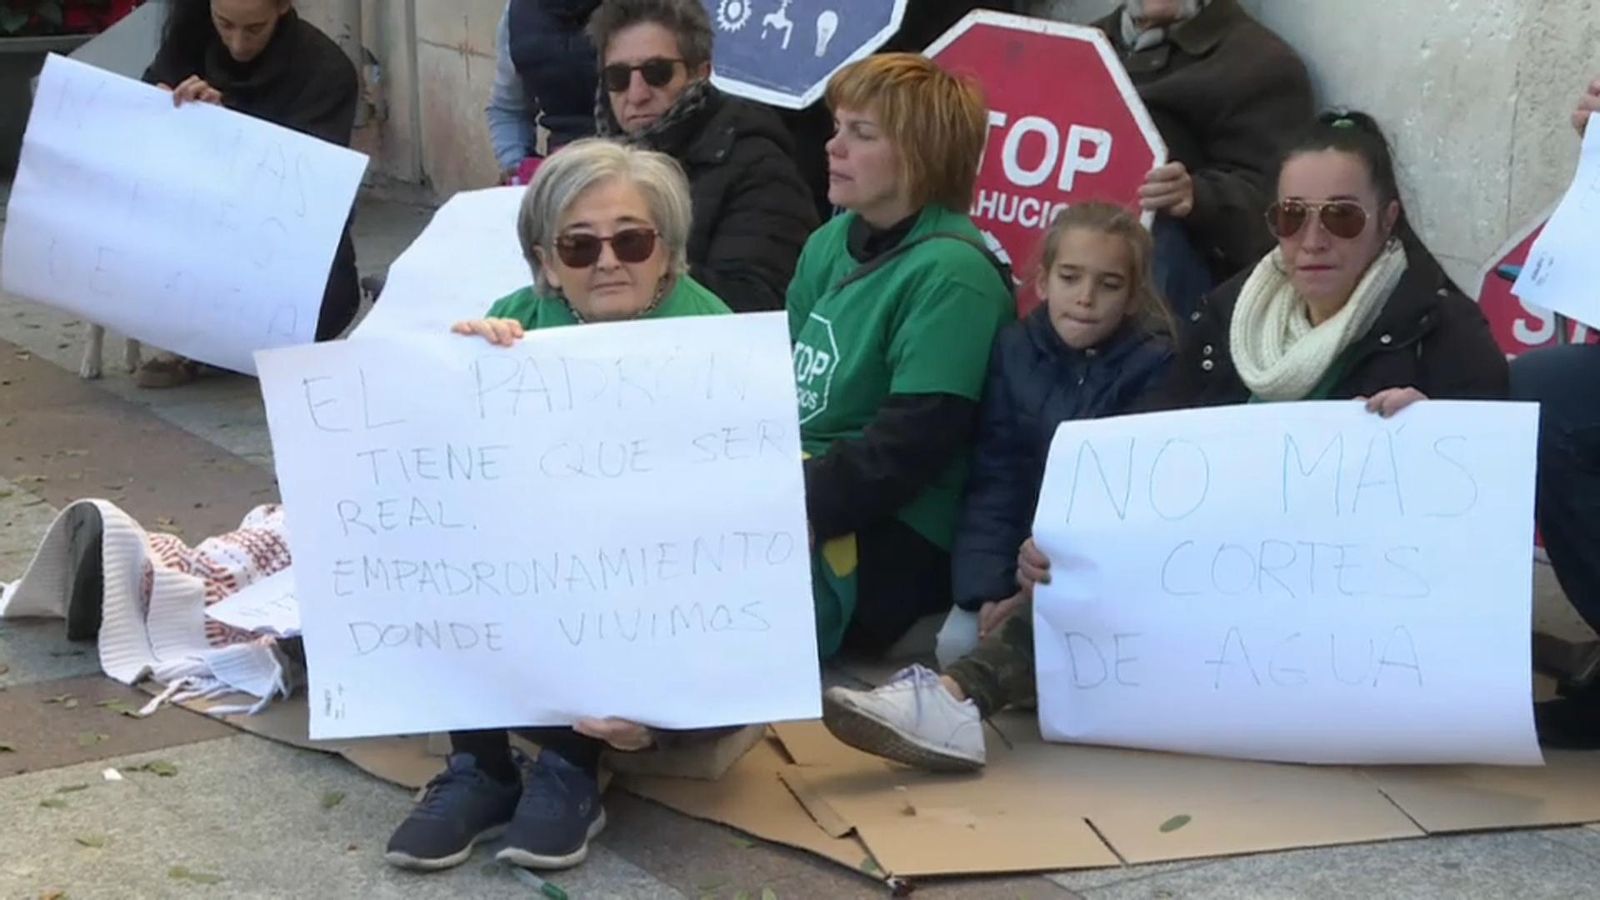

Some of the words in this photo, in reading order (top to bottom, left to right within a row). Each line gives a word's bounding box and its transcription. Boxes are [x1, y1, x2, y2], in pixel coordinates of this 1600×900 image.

[302, 366, 407, 432] EL
[356, 443, 512, 485] TIENE
[539, 437, 656, 482] QUE
[692, 418, 787, 463] SER
[1065, 436, 1211, 525] NO
[1282, 423, 1480, 517] MÁS
[336, 496, 480, 536] REAL.
[331, 530, 793, 598] EMPADRONAMIENTO
[1161, 538, 1433, 599] CORTES
[348, 621, 506, 656] DONDE
[558, 600, 771, 648] VIVIMOS
[1064, 630, 1146, 690] DE
[1204, 623, 1425, 690] AGUA
